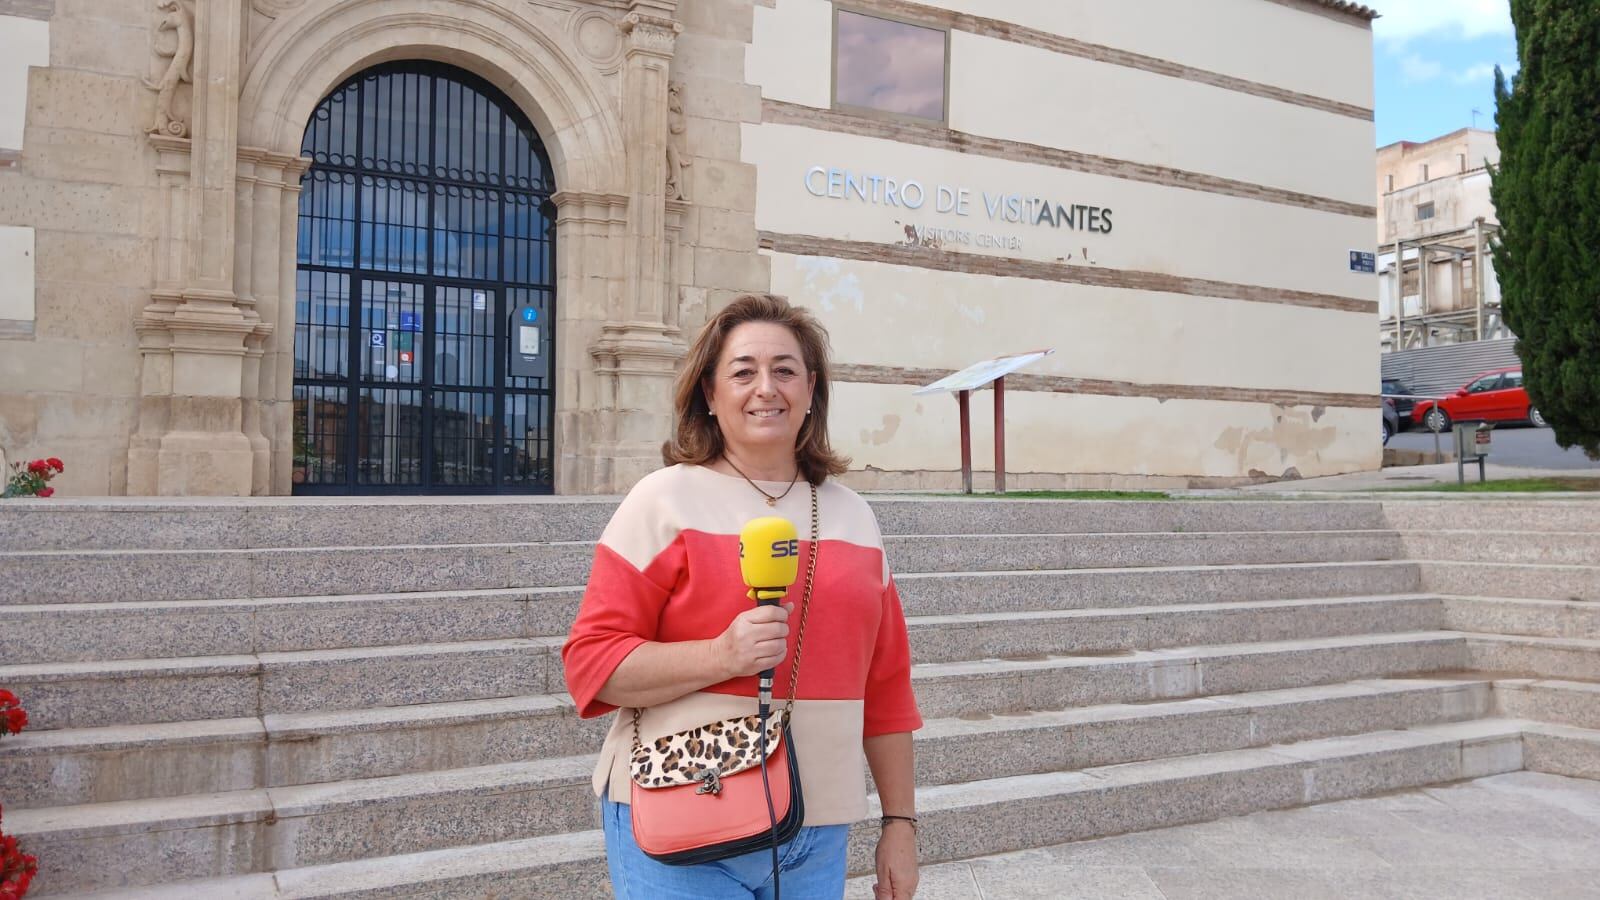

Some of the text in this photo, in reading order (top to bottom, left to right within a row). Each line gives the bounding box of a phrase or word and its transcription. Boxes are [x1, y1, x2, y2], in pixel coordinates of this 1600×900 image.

[805, 165, 1113, 234] CENTRO DE VISITANTES
[912, 223, 1023, 250] VISITORS CENTER
